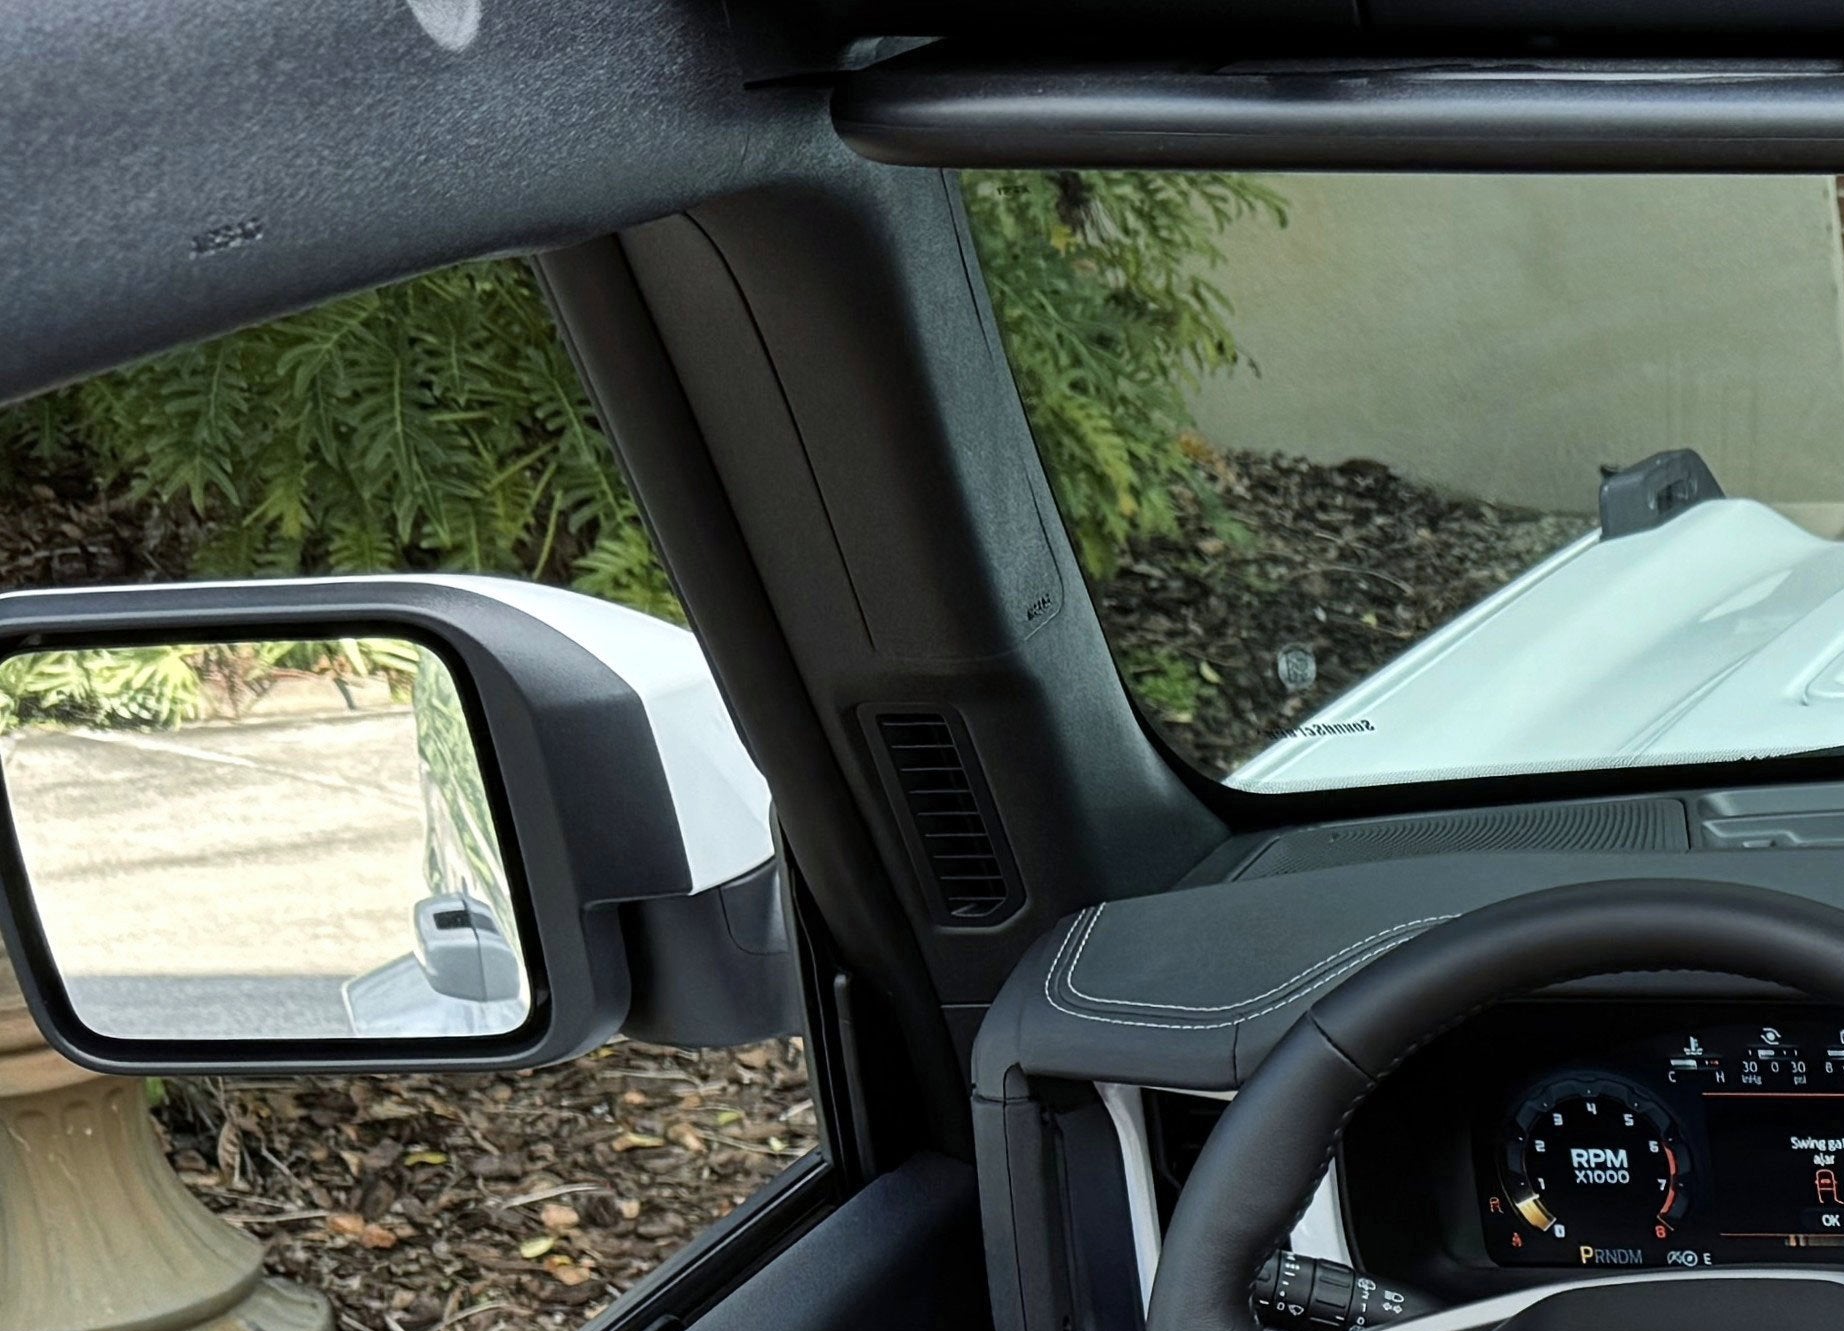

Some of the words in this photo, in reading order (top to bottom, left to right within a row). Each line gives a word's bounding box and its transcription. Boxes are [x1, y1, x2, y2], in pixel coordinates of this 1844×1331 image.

[1742, 1062, 1758, 1073] 30
[1771, 1061, 1779, 1072] 0
[1791, 1062, 1806, 1073] 30
[1668, 1071, 1676, 1083] C
[1715, 1071, 1725, 1083] H
[1586, 1103, 1597, 1115] 4
[1553, 1113, 1563, 1126] 3
[1623, 1114, 1634, 1126] 5
[1534, 1140, 1546, 1152] 2
[1649, 1140, 1659, 1152] 6
[1791, 1136, 1826, 1150] Swing
[1570, 1148, 1628, 1168] RPM
[1813, 1153, 1835, 1166] ajar
[1575, 1170, 1630, 1184] X1000
[1538, 1178, 1545, 1190] 1
[1657, 1179, 1667, 1190] 7
[1822, 1214, 1840, 1226] OK
[1554, 1224, 1565, 1238] 0
